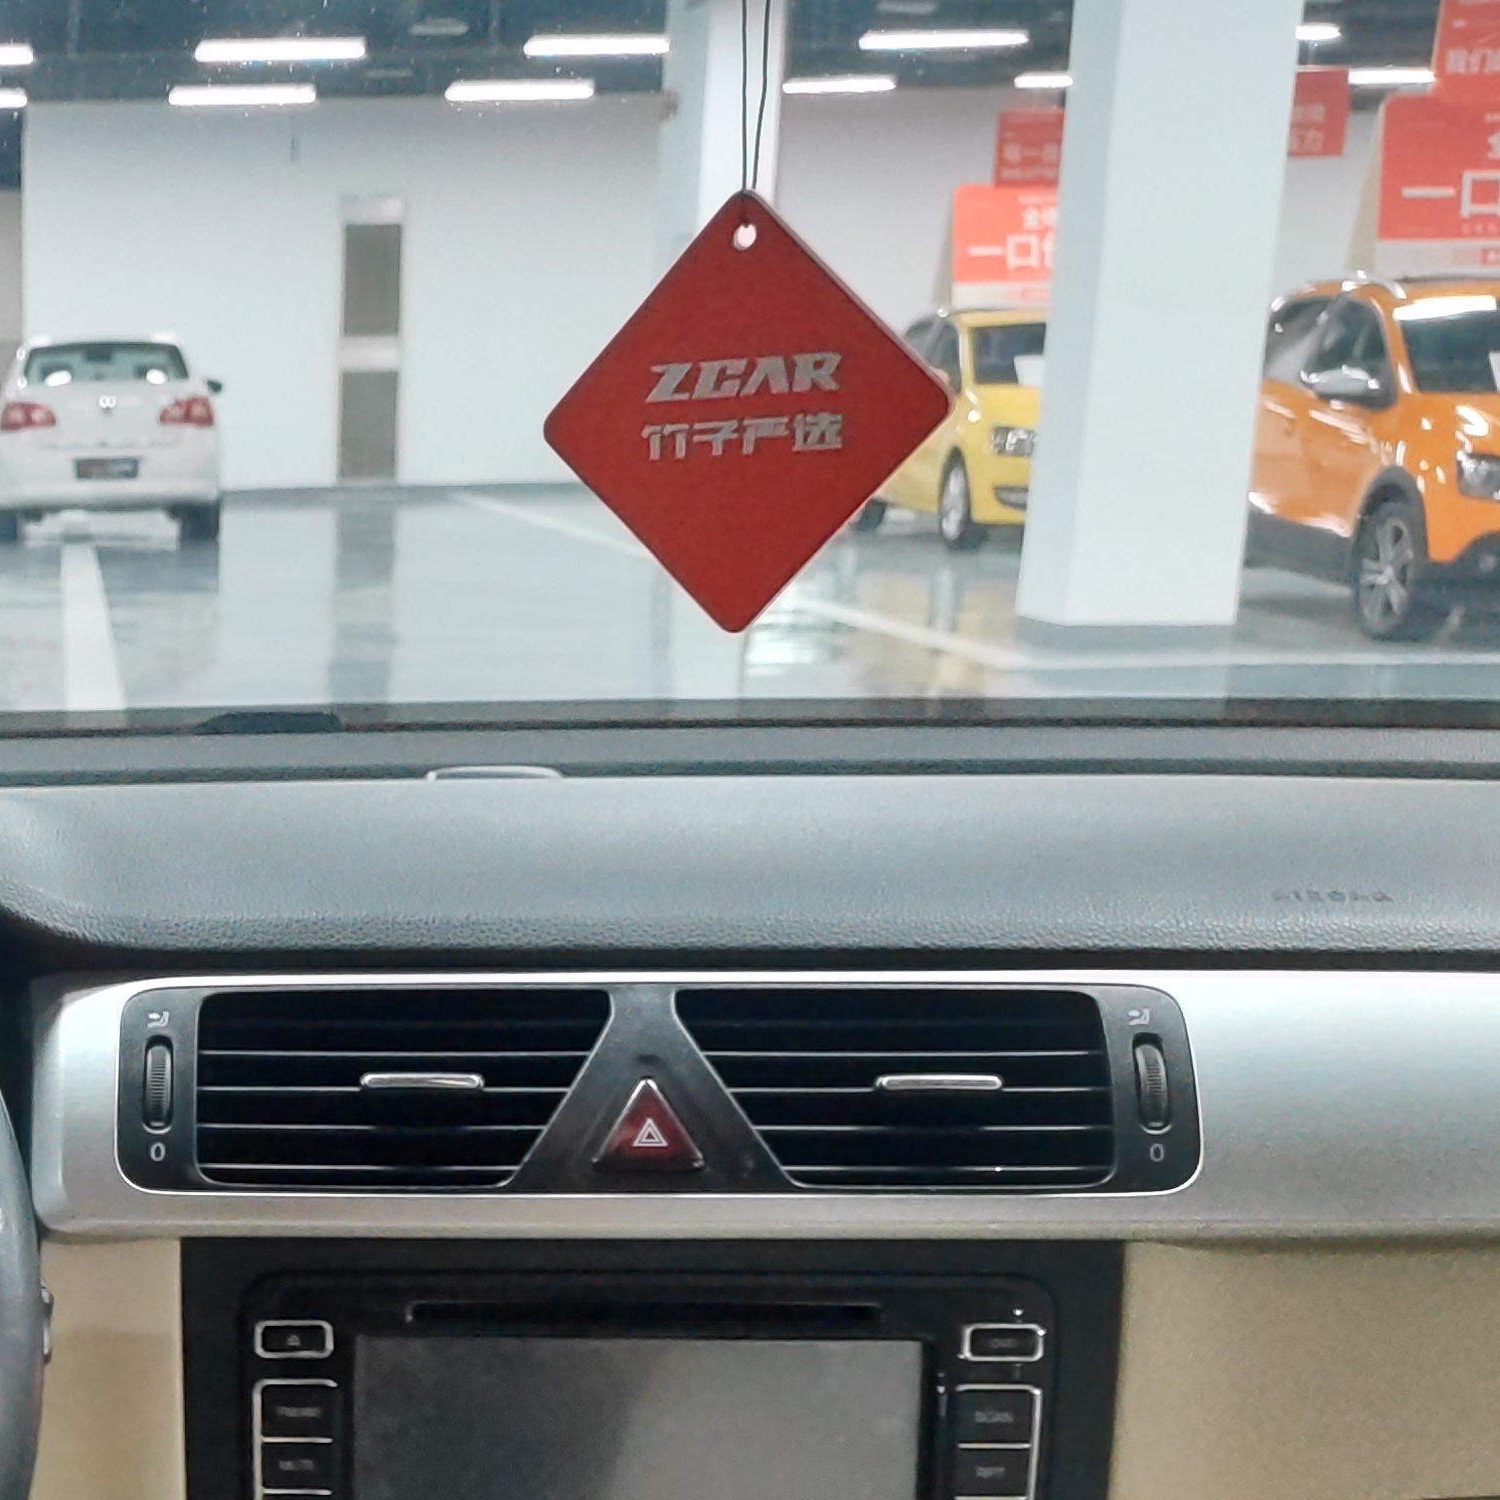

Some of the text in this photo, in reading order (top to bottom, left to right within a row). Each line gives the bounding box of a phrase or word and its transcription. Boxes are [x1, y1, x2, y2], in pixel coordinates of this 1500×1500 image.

[645, 350, 842, 404] ZCAR
[640, 411, 843, 461] 竹子严选
